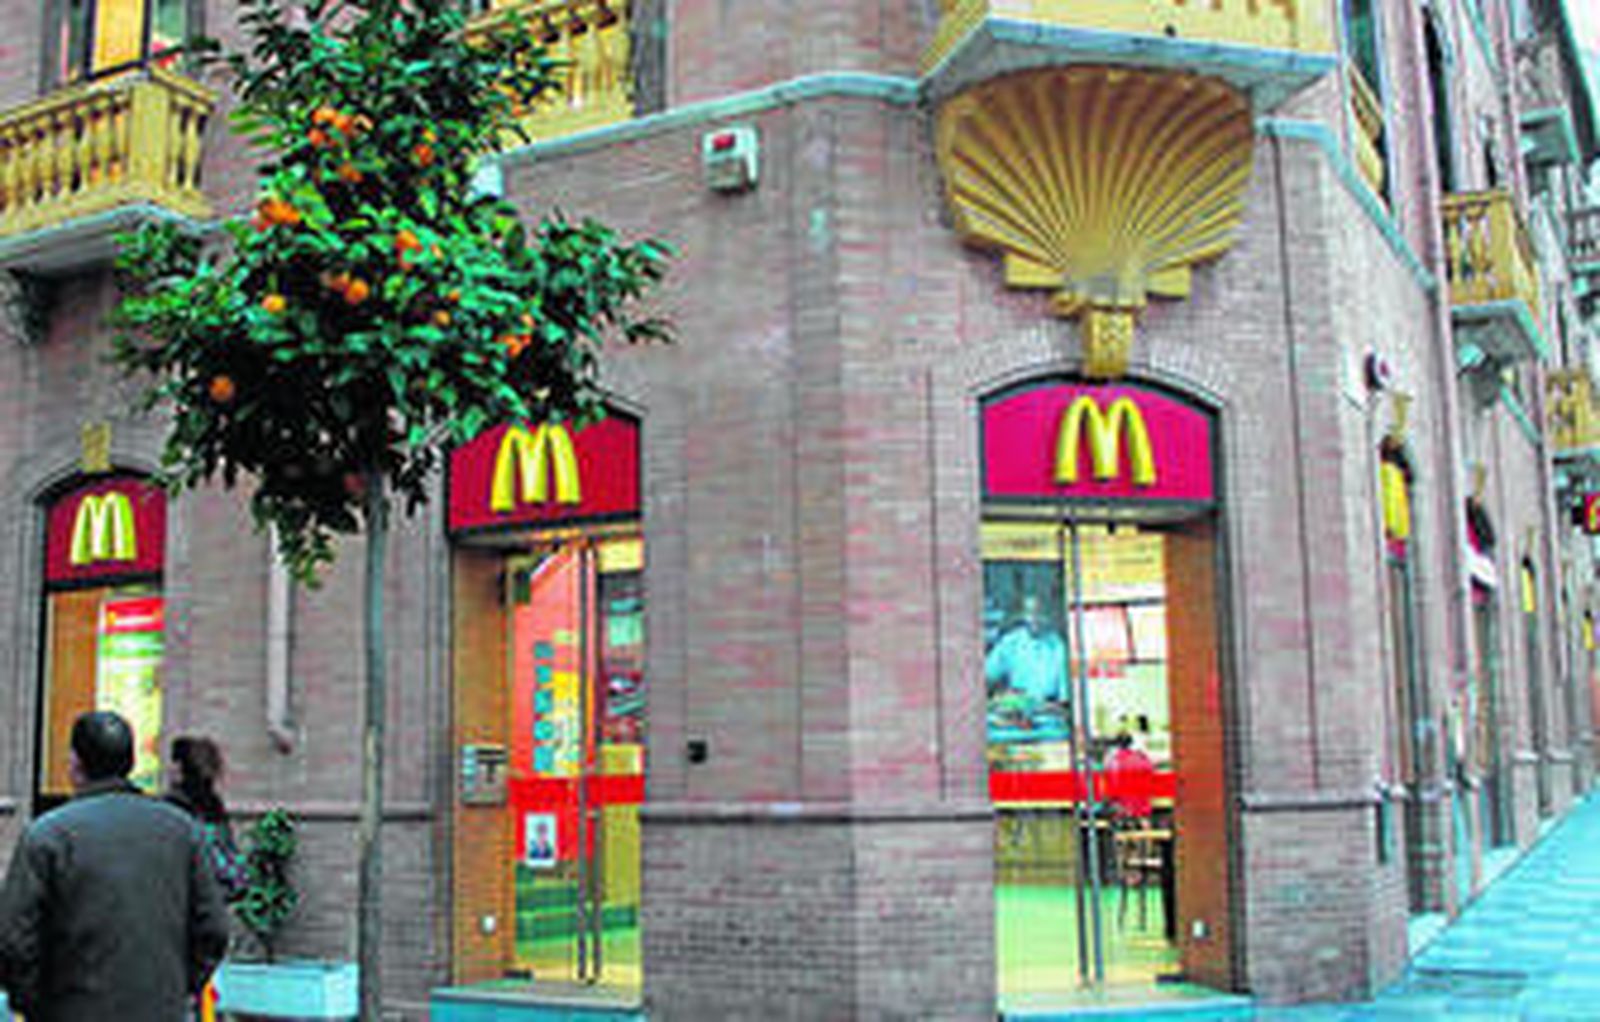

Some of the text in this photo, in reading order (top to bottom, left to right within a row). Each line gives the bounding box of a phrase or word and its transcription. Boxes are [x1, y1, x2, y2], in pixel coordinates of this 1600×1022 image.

[490, 423, 580, 512] M
[1054, 395, 1157, 485] M
[71, 490, 136, 565] M
